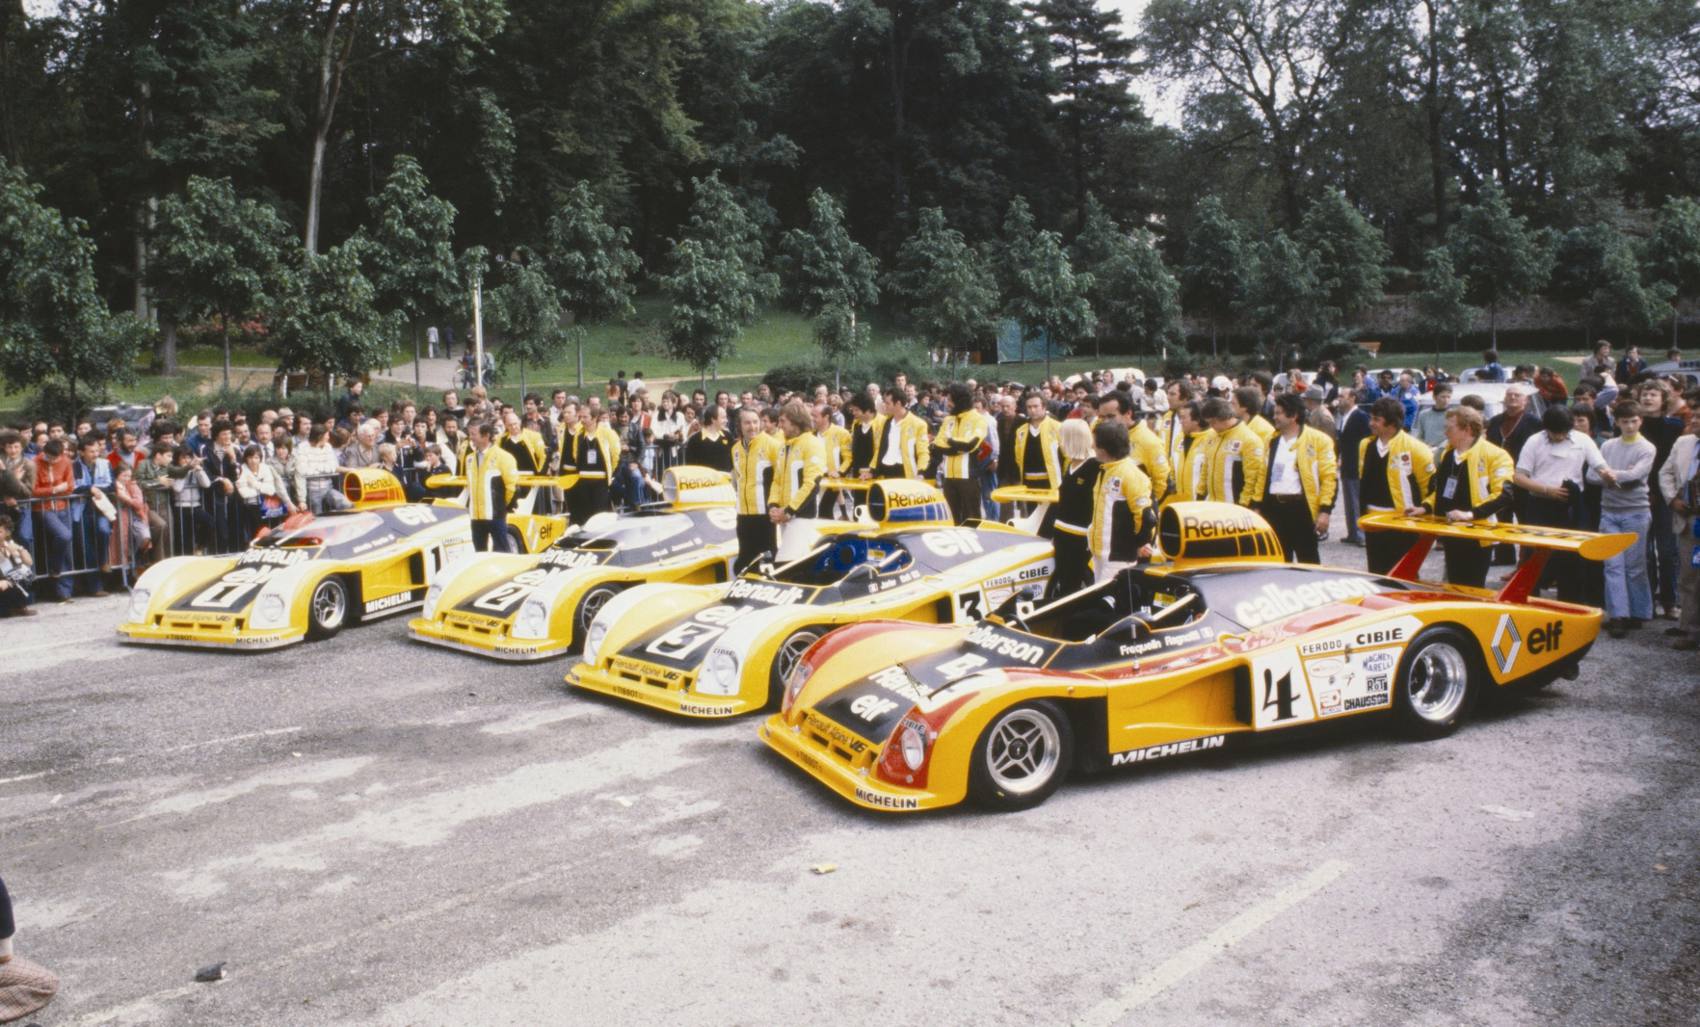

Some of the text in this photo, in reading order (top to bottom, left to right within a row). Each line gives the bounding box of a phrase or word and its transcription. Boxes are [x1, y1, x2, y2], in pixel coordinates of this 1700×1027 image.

[540, 524, 553, 539] elf
[1183, 515, 1257, 539] Renault
[921, 529, 984, 558] elf
[365, 591, 412, 614] MICHELIN
[724, 578, 804, 605] Renault
[958, 590, 983, 622] 3
[1235, 576, 1381, 627] calberson
[655, 624, 706, 654] 3
[966, 624, 1045, 666] alberson
[1526, 621, 1563, 655] elf
[850, 693, 899, 723] elf
[1262, 667, 1301, 722] 4
[1343, 692, 1389, 711] CHAUSSON
[680, 703, 733, 716] MICHELIN
[1111, 735, 1225, 767] MICHELIN
[854, 788, 918, 809] MICHELIN
